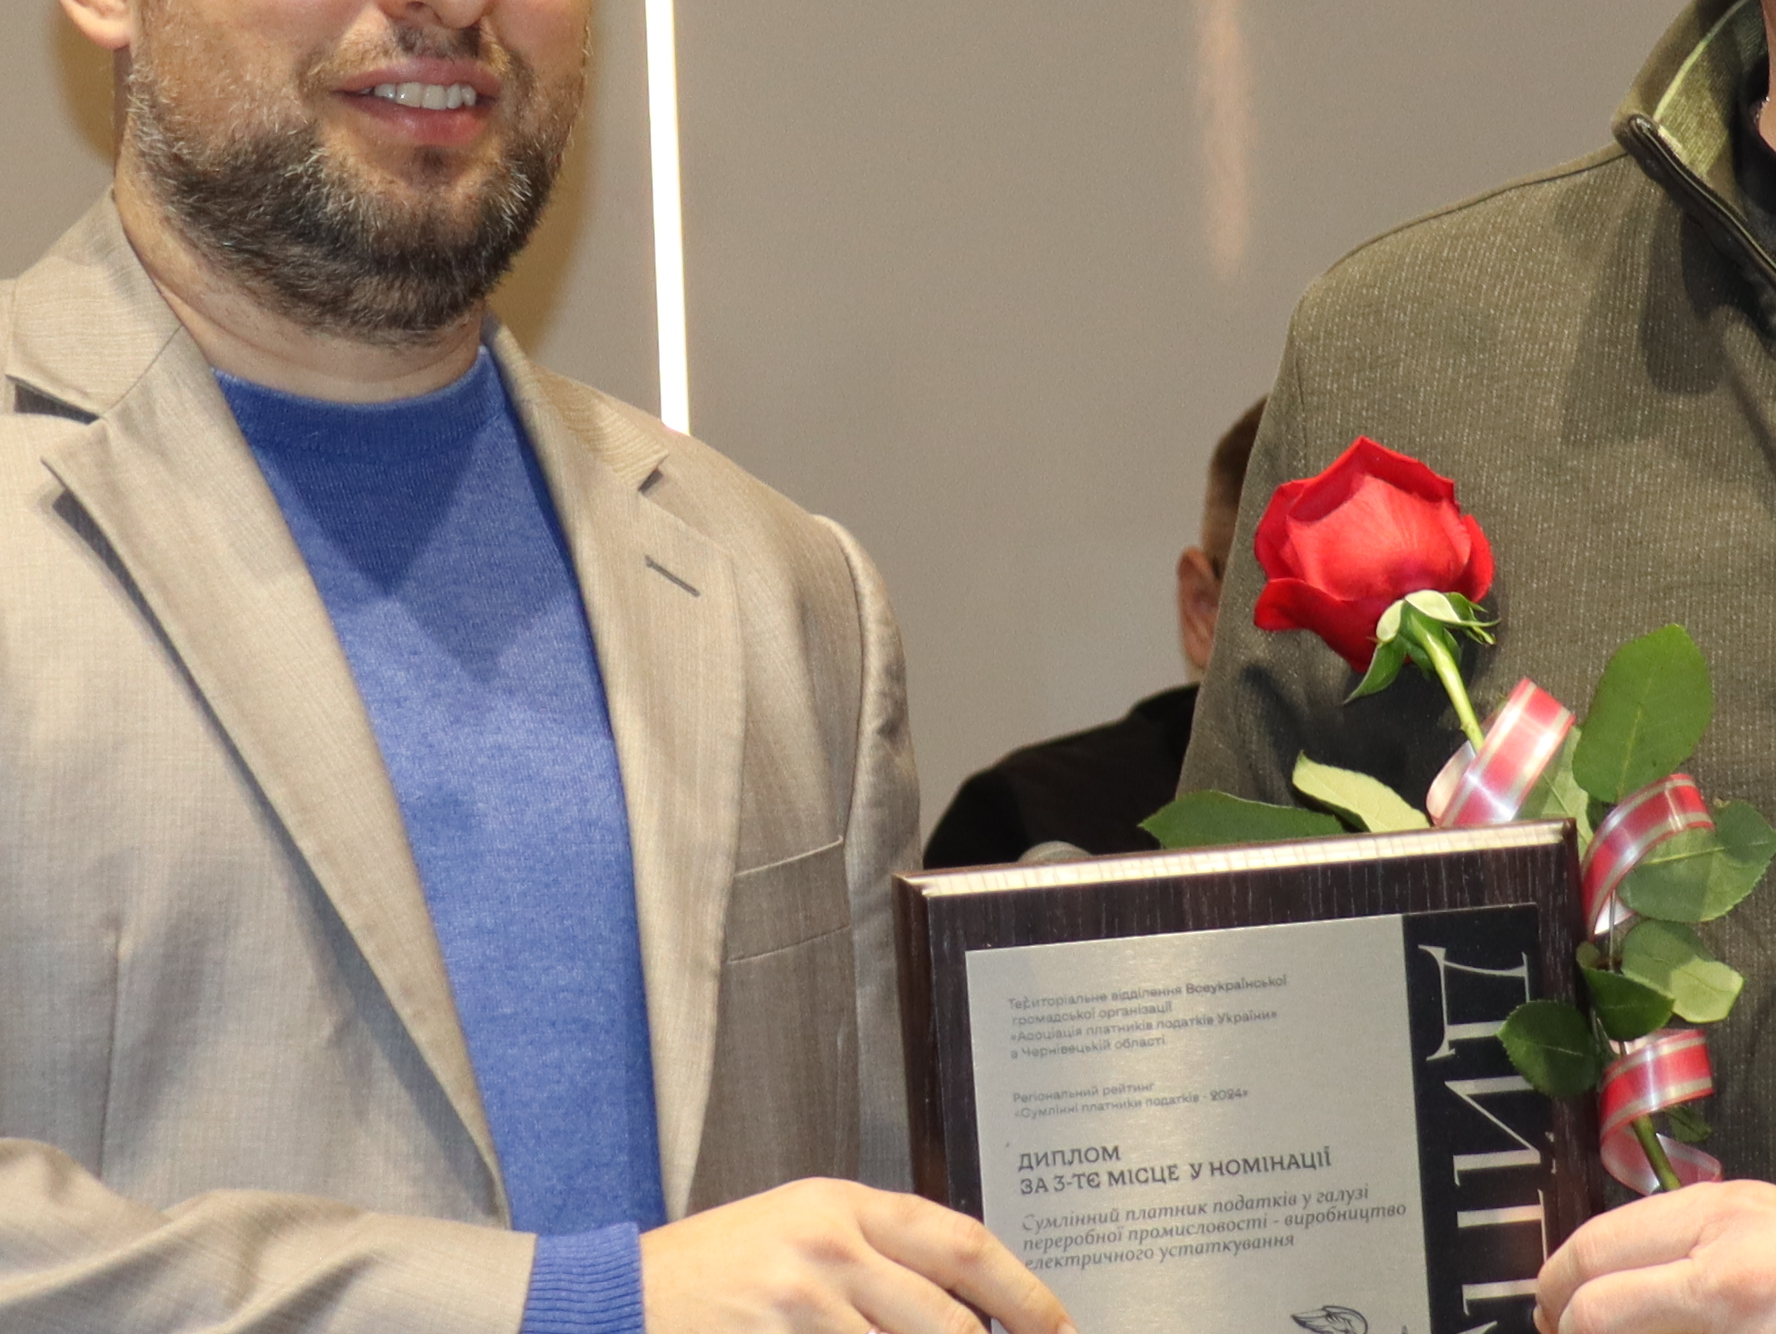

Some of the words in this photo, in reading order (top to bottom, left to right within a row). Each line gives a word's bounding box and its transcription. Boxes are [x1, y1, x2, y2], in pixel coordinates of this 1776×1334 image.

[1018, 1145, 1121, 1172] ДИПЛОМ
[1020, 1177, 1049, 1195] ЗА
[1053, 1172, 1101, 1193] 3-ТЄ
[1108, 1165, 1180, 1187] МІСЦЕ
[1189, 1162, 1203, 1180] У
[1210, 1145, 1332, 1176] НОМІНАЦІЇ
[1022, 1208, 1120, 1235] Сумлінний
[1125, 1202, 1208, 1222] платник
[1212, 1190, 1297, 1213] податків
[1301, 1193, 1312, 1209] у
[1316, 1183, 1369, 1203] галузі
[1023, 1227, 1123, 1254] переробної
[1128, 1213, 1268, 1245] промисловості
[1284, 1204, 1407, 1230] виробництво
[1024, 1247, 1154, 1270] електричного
[1159, 1234, 1294, 1263] устаткування
